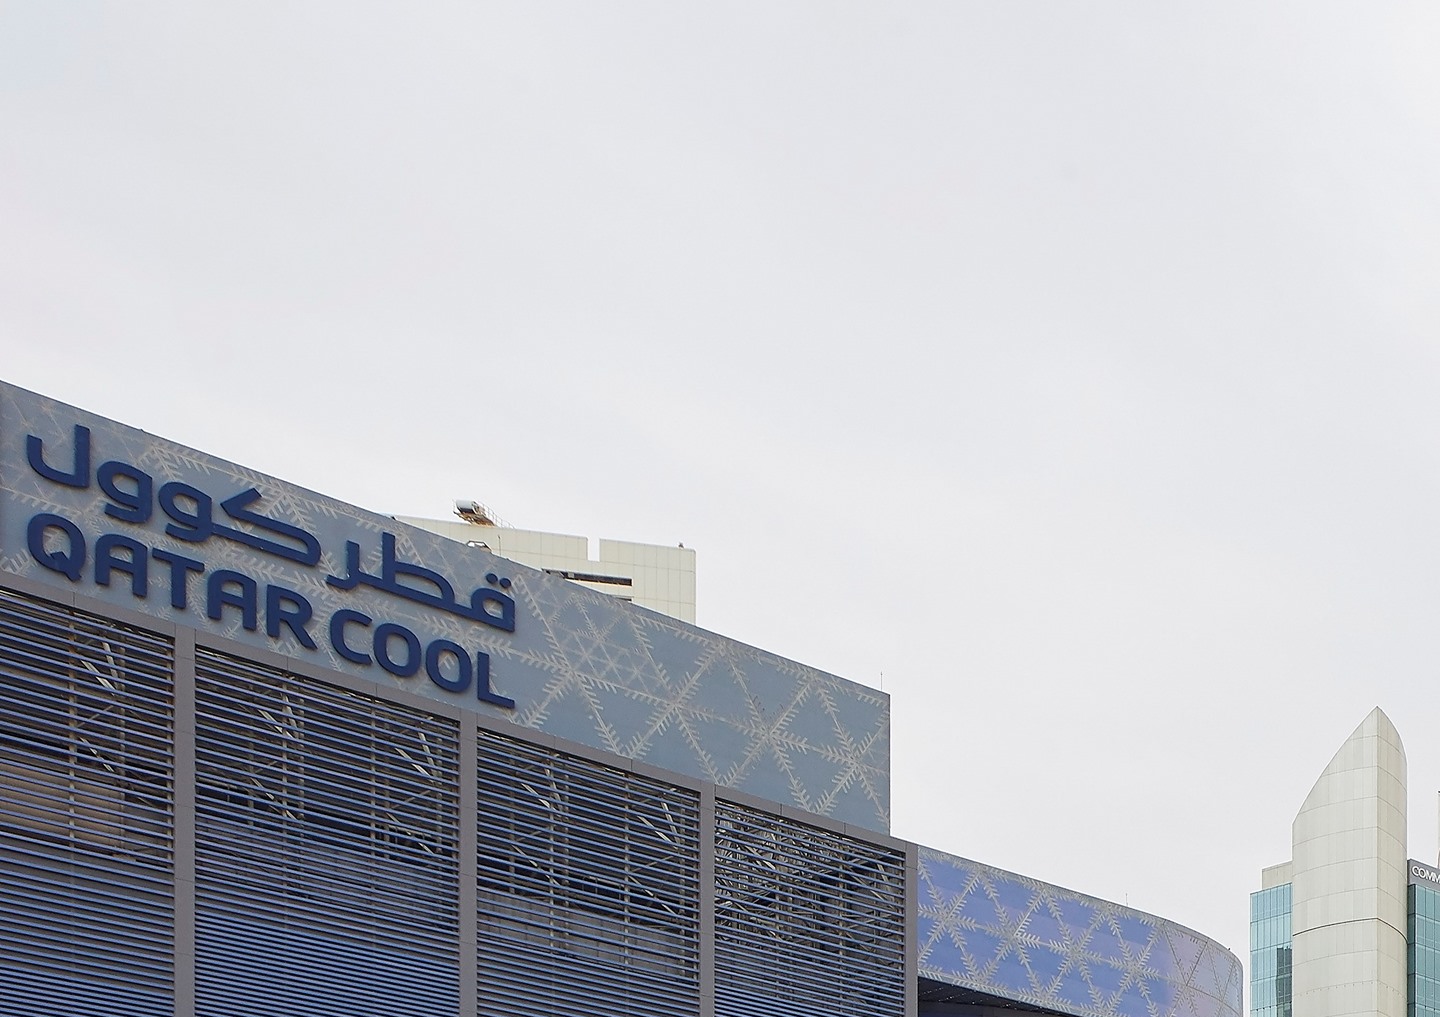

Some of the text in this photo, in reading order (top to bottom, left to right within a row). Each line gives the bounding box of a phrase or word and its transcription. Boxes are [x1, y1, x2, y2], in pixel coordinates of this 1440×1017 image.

[26, 424, 515, 633] قطر كوول
[26, 513, 515, 709] QATAR COOL
